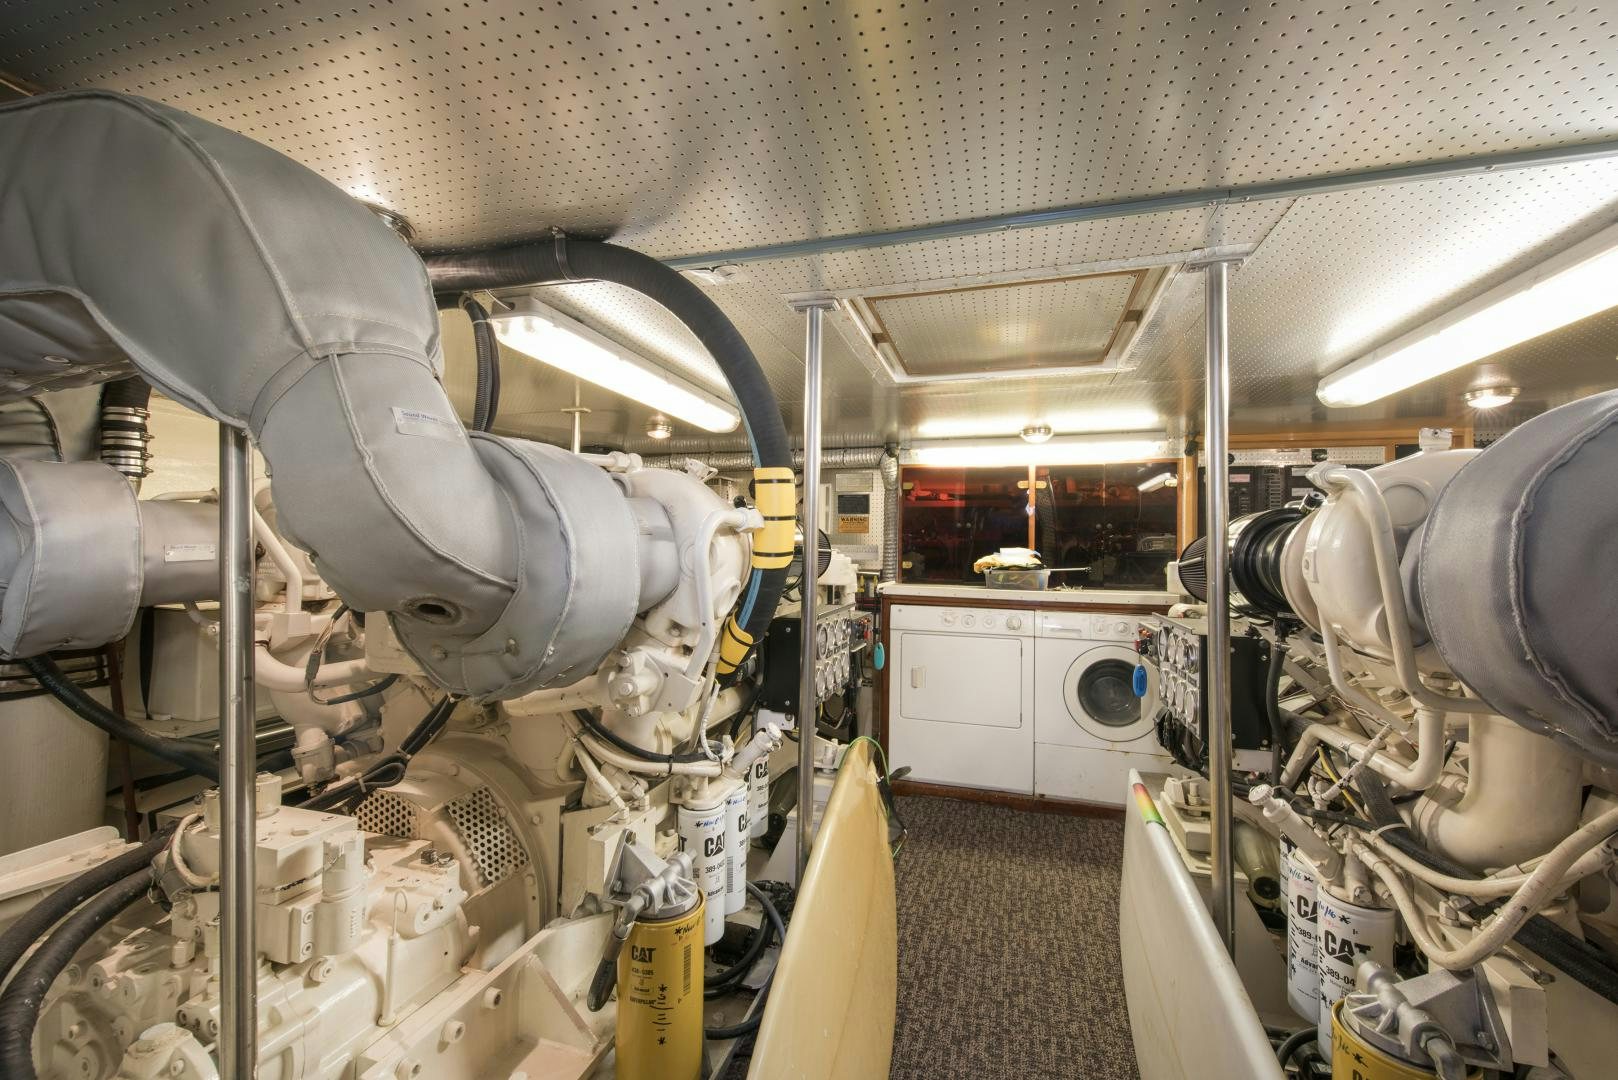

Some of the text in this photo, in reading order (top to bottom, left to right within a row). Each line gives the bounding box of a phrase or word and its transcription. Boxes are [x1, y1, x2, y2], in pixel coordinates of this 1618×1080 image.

[756, 761, 768, 779] CA
[1296, 894, 1318, 924] CA
[631, 944, 656, 963] CAT
[1324, 929, 1371, 967] CAT
[1325, 965, 1356, 986] 389-04
